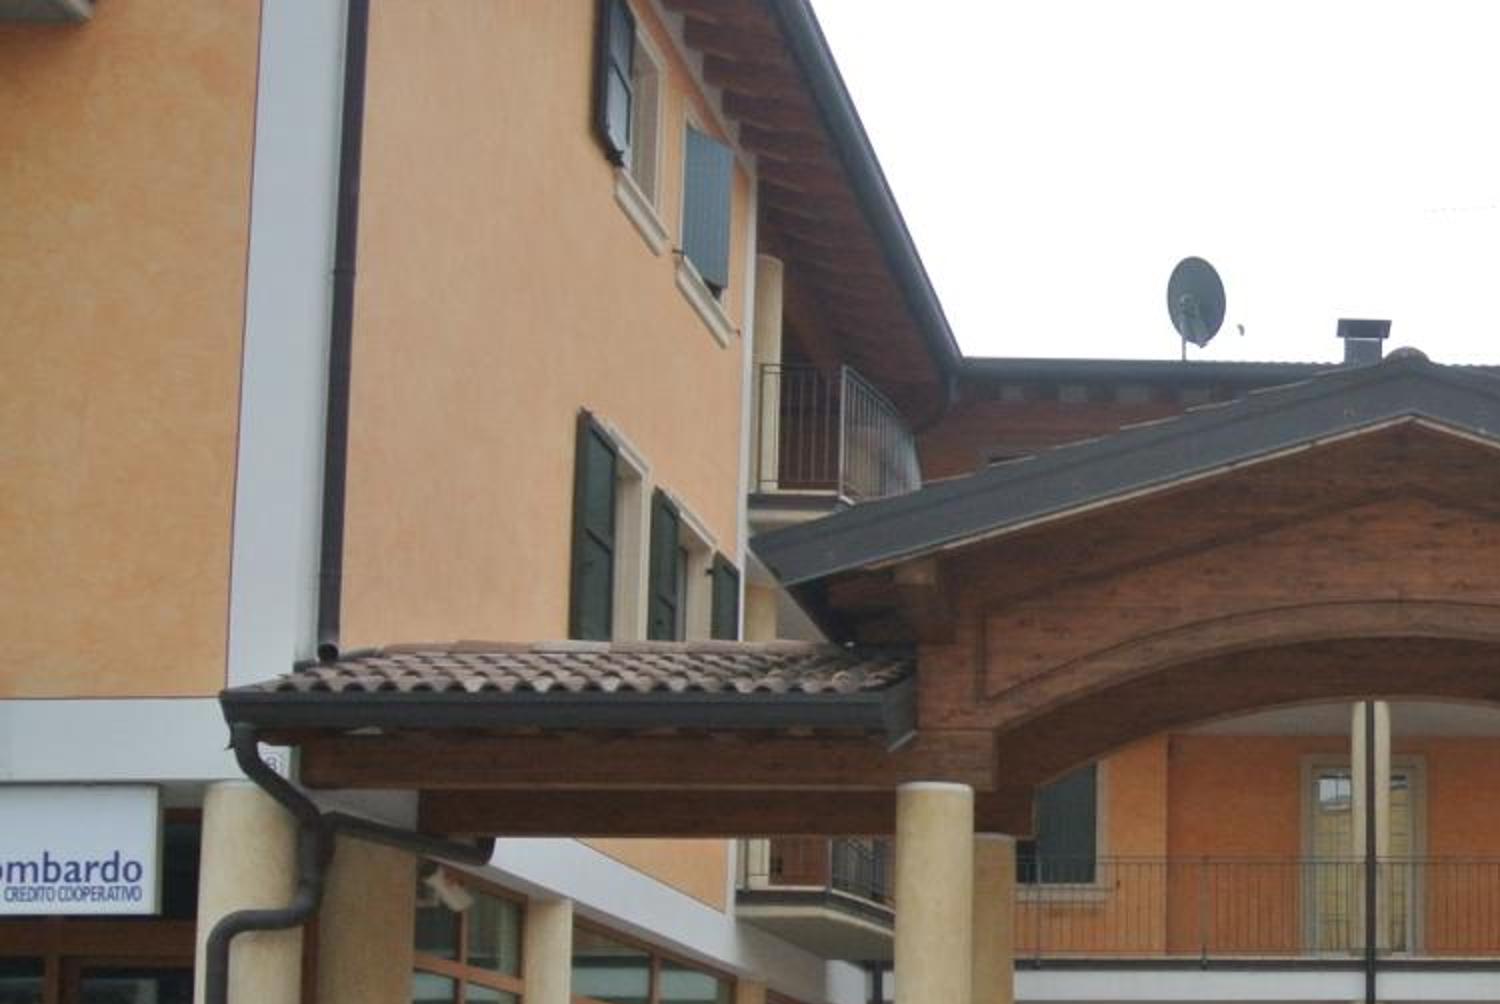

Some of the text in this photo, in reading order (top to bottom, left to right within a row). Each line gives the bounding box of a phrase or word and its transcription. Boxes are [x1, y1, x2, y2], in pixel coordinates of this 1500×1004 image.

[0, 850, 143, 883] mbardo
[4, 885, 143, 902] CREDITO COOPERATIVO
